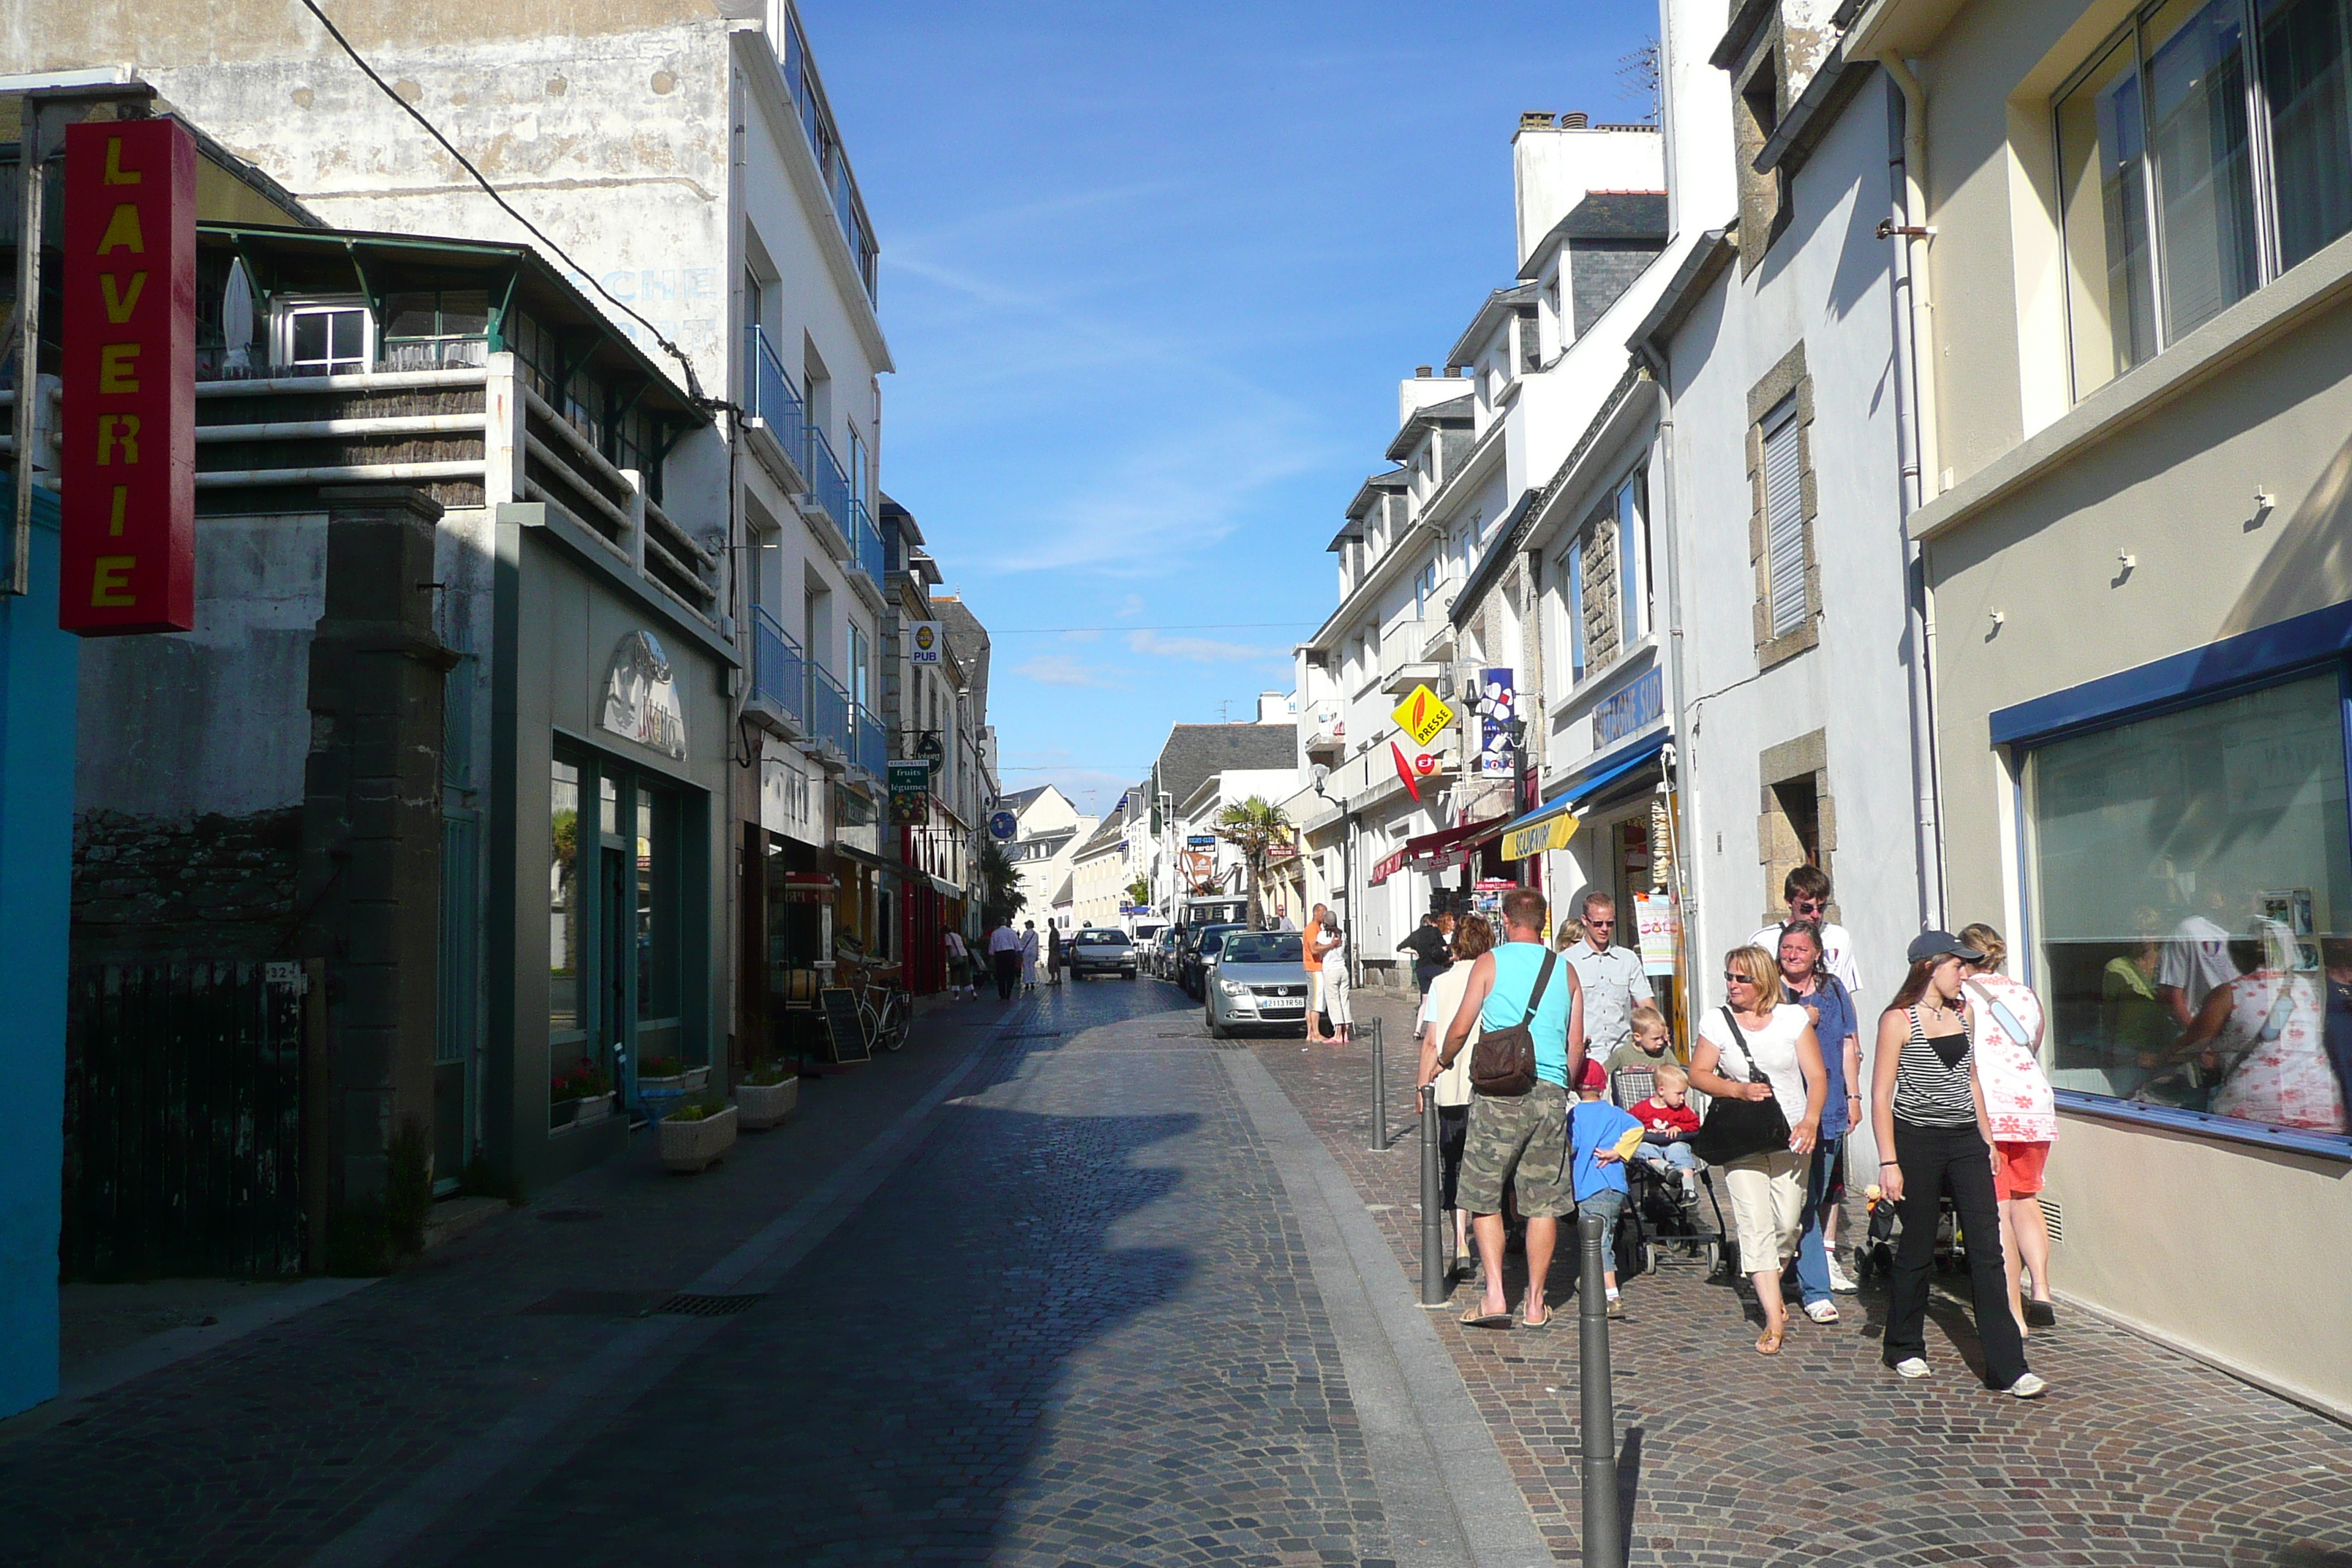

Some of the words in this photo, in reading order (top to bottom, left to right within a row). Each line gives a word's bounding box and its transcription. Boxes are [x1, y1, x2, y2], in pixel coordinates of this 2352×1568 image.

[91, 136, 148, 608] LAVERIE
[914, 652, 937, 661] PUB
[1640, 674, 1660, 725] SUD
[1417, 709, 1449, 742] PRESSE
[891, 783, 927, 793] légumes
[271, 967, 287, 979] 32
